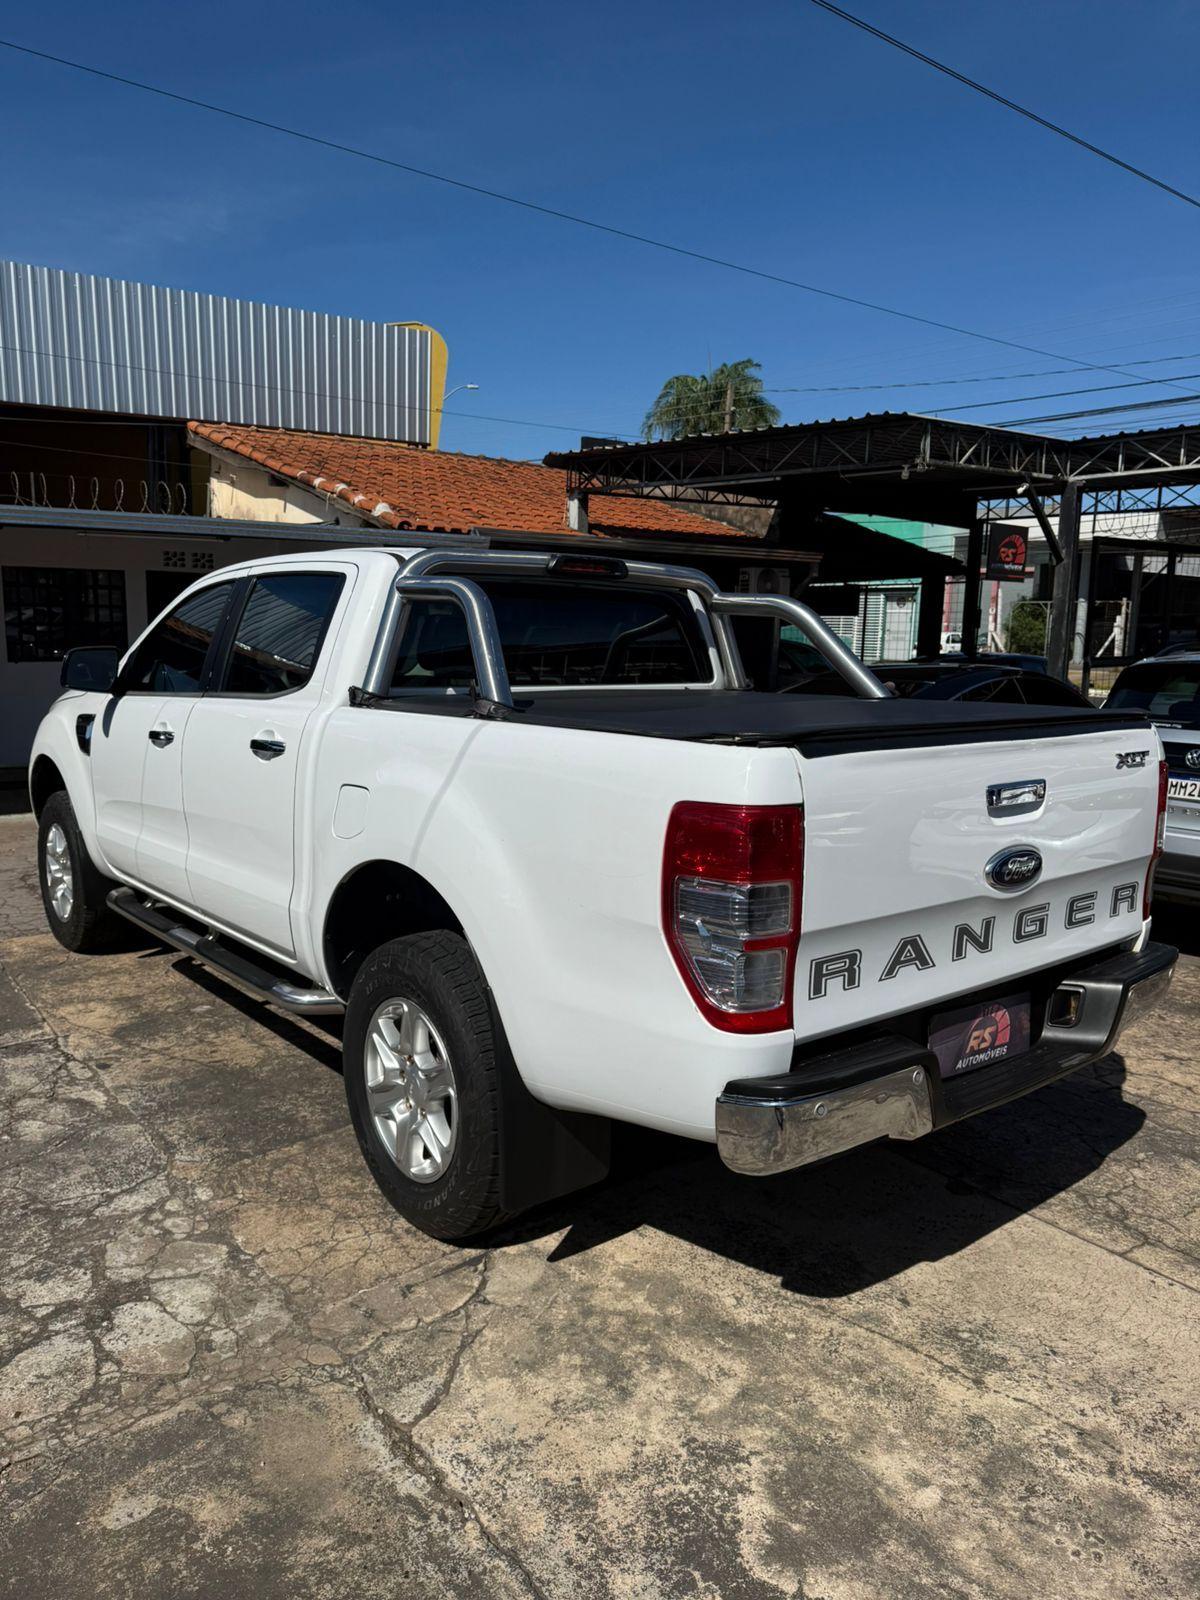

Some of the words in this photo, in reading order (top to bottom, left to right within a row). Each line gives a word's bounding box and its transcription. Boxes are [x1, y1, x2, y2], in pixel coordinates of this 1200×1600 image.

[1115, 750, 1150, 770] XLT
[808, 881, 1140, 1001] RANGER
[965, 1024, 997, 1054] RS
[955, 1045, 1008, 1071] AUTOMÓVEIS
